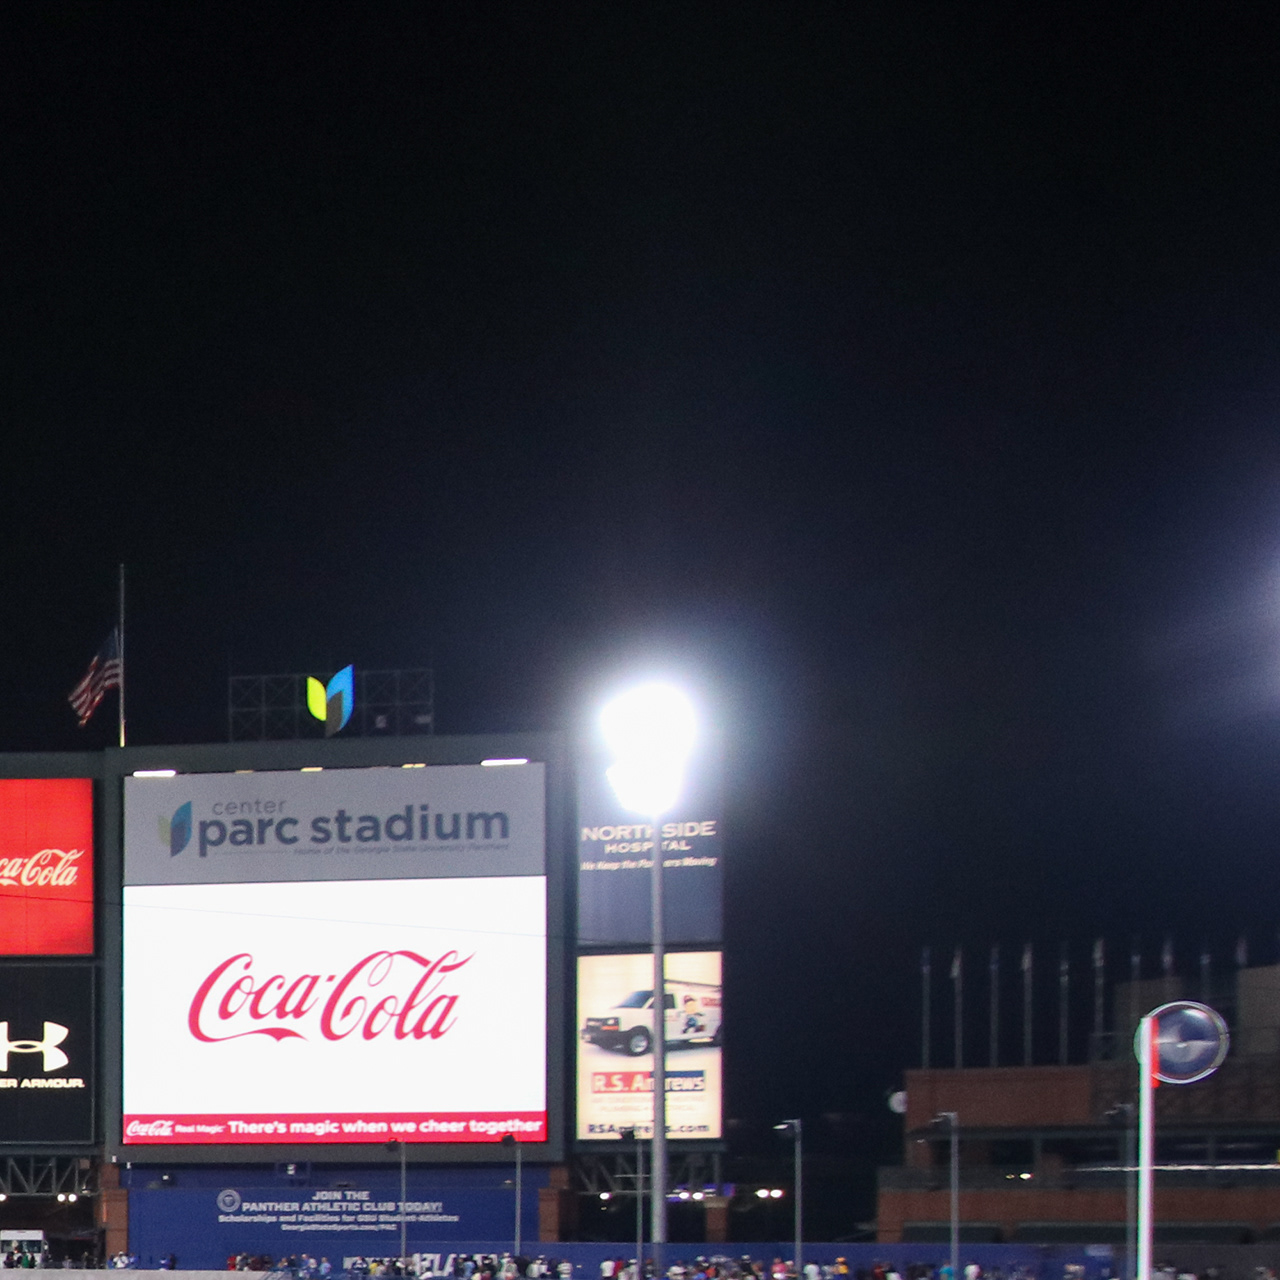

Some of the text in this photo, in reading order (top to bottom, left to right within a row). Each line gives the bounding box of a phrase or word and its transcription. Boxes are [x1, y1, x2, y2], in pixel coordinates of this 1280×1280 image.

[211, 798, 288, 816] center
[199, 803, 511, 858] parc stadium
[604, 840, 692, 854] HOSPTAL
[188, 950, 477, 1043] Coca-Cola
[593, 1075, 706, 1092] R.S. Anrews
[126, 1119, 175, 1136] Coca-Cola
[175, 1124, 195, 1133] Real
[227, 1120, 287, 1134] There's
[290, 1119, 340, 1136] magic
[341, 1119, 388, 1133] when
[391, 1121, 417, 1133] we
[419, 1119, 467, 1132] cheer
[469, 1118, 543, 1134] together
[312, 1190, 371, 1201] JOIN THE
[241, 1202, 300, 1212] PANTHER
[301, 1202, 361, 1212] ATHLETIC
[362, 1202, 395, 1211] CLUB
